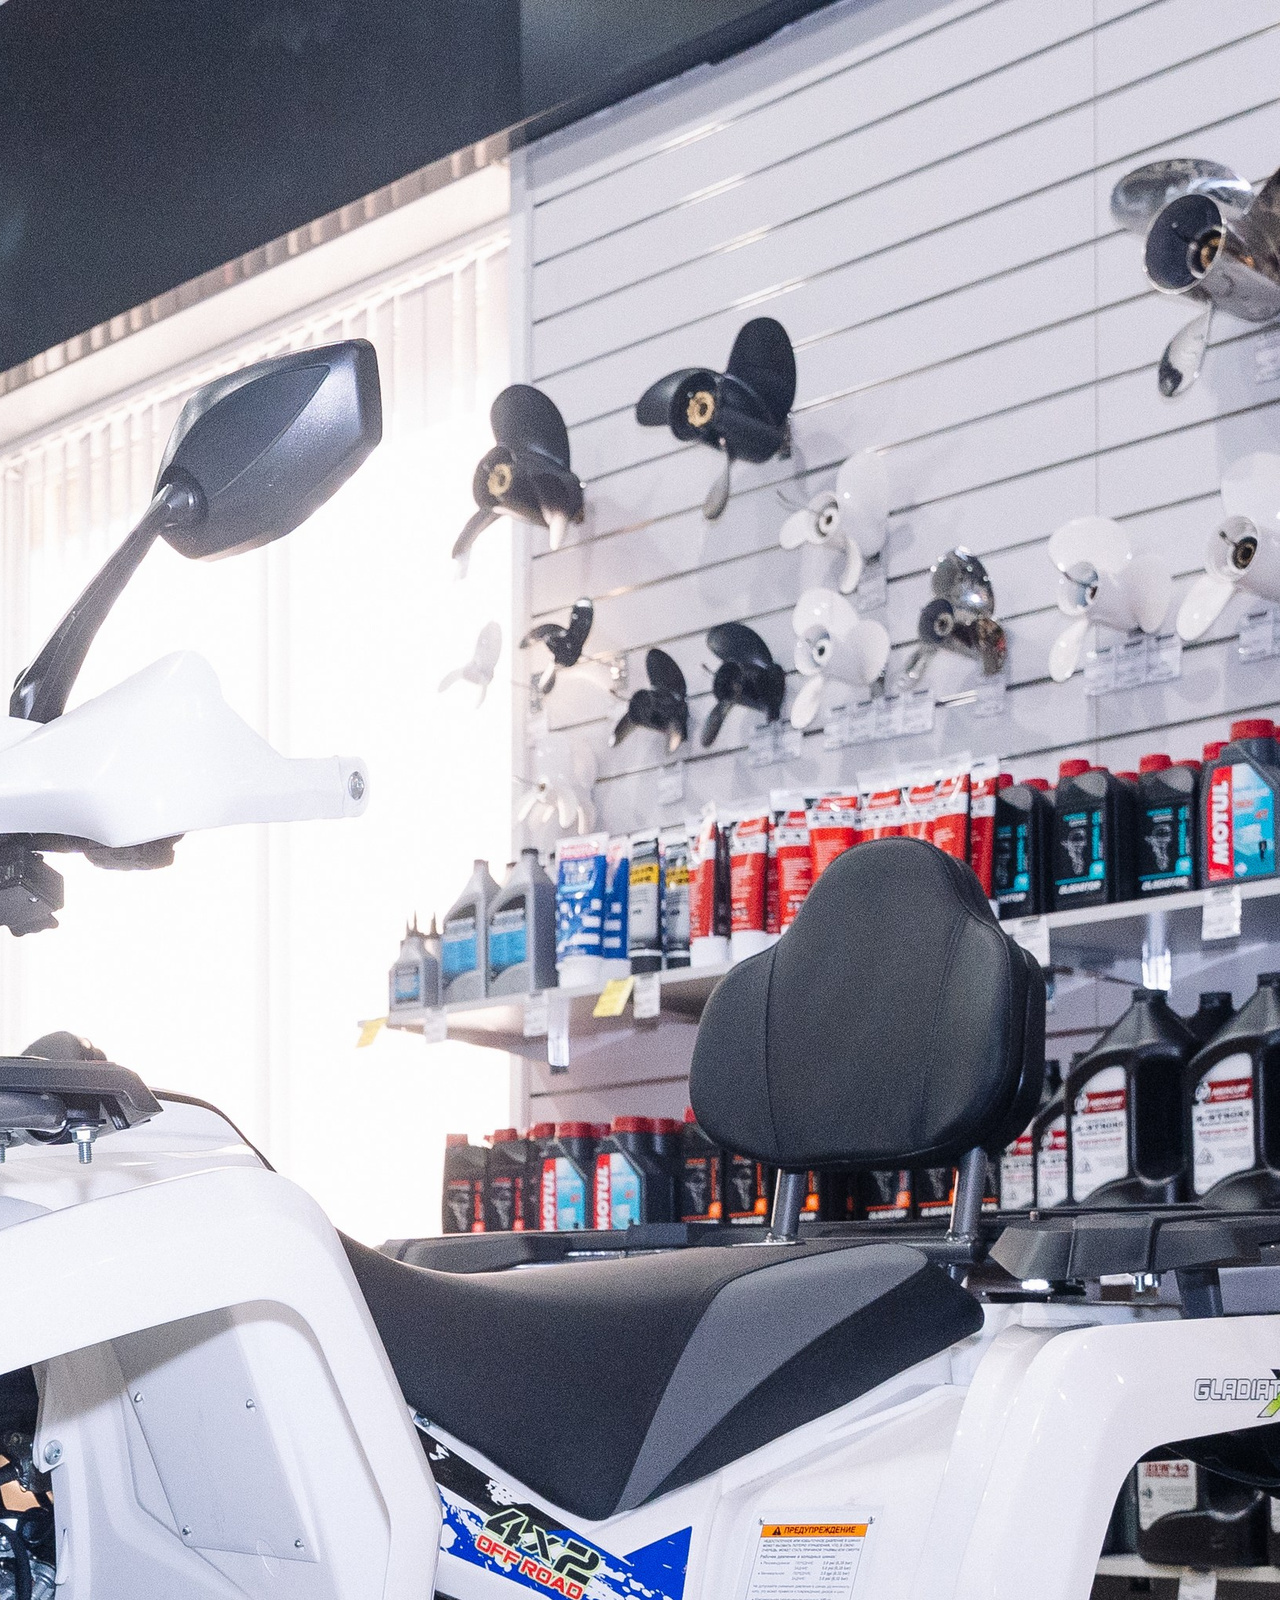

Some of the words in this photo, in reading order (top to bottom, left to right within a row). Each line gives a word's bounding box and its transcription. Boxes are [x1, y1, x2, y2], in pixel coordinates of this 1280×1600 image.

[1210, 779, 1231, 867] MOTUL
[783, 1525, 856, 1534] ПРЕДУПРЕЖДЕНИЕ
[476, 1534, 520, 1567] OFF
